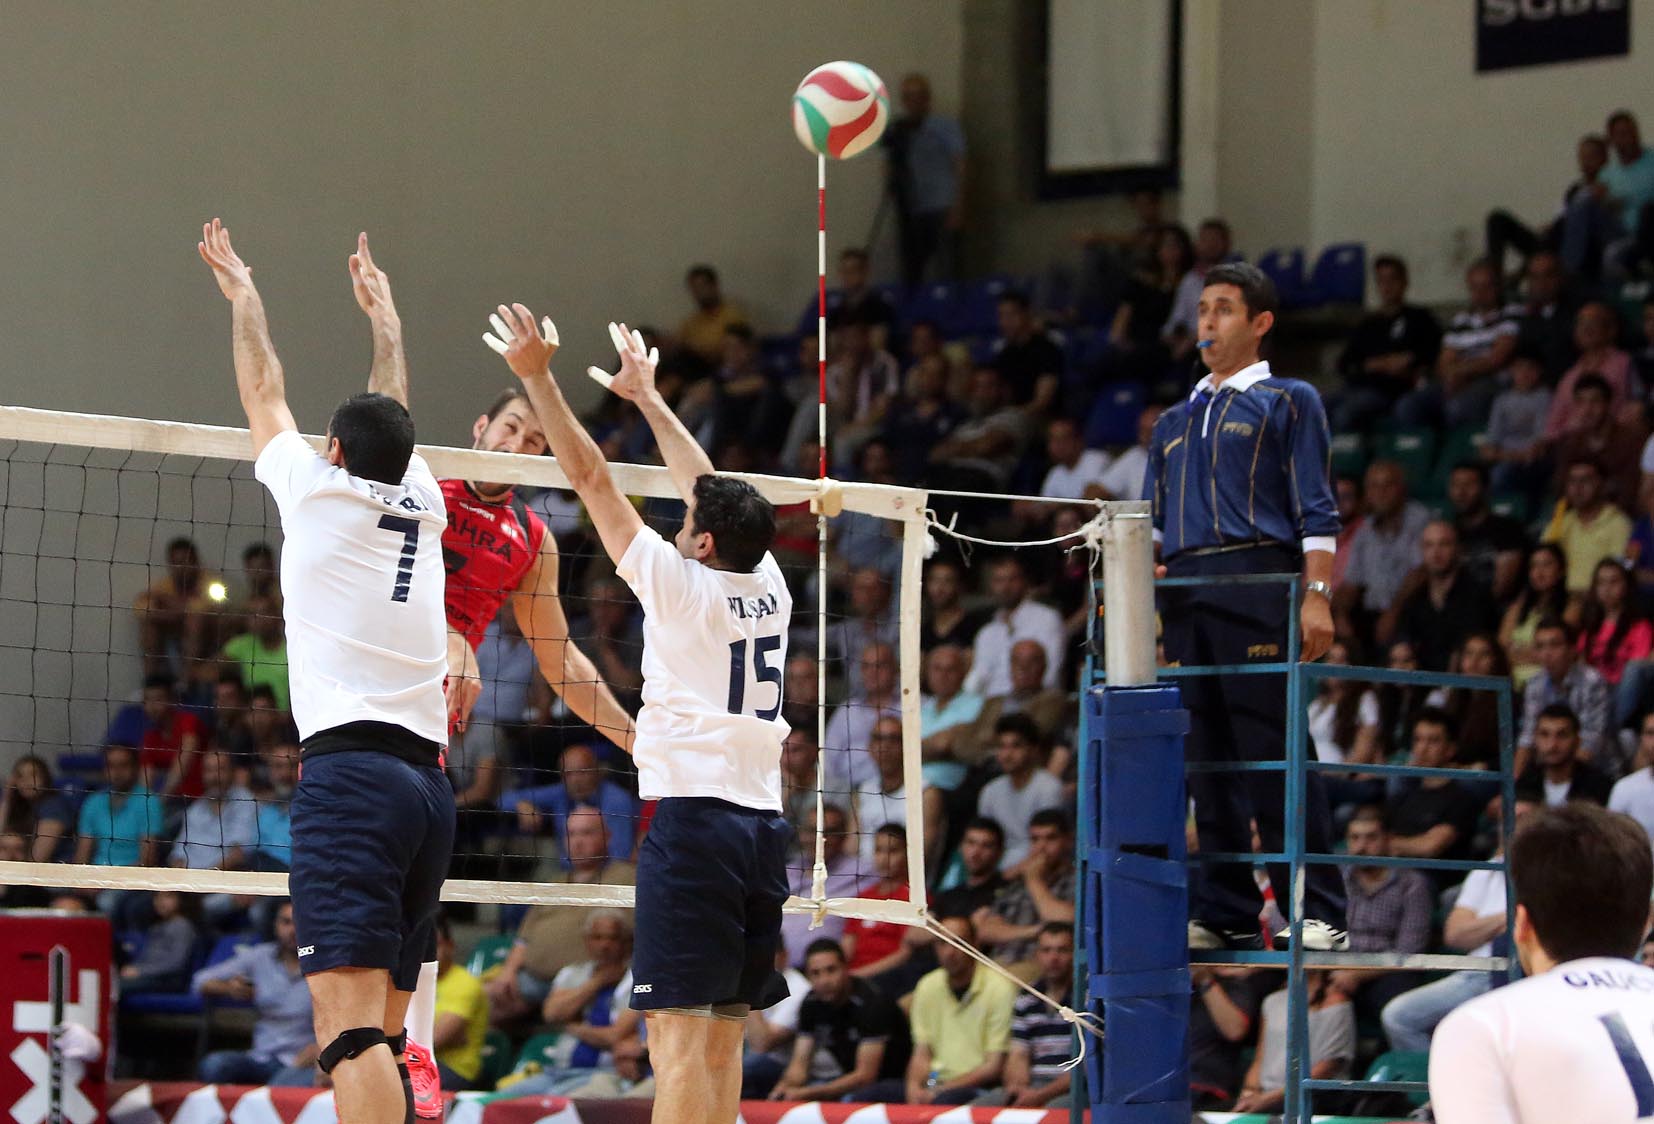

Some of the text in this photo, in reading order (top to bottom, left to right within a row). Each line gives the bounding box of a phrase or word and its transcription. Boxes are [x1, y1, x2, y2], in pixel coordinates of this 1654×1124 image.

[377, 513, 420, 602] 7
[446, 511, 512, 563] AHRA
[727, 634, 782, 722] 15
